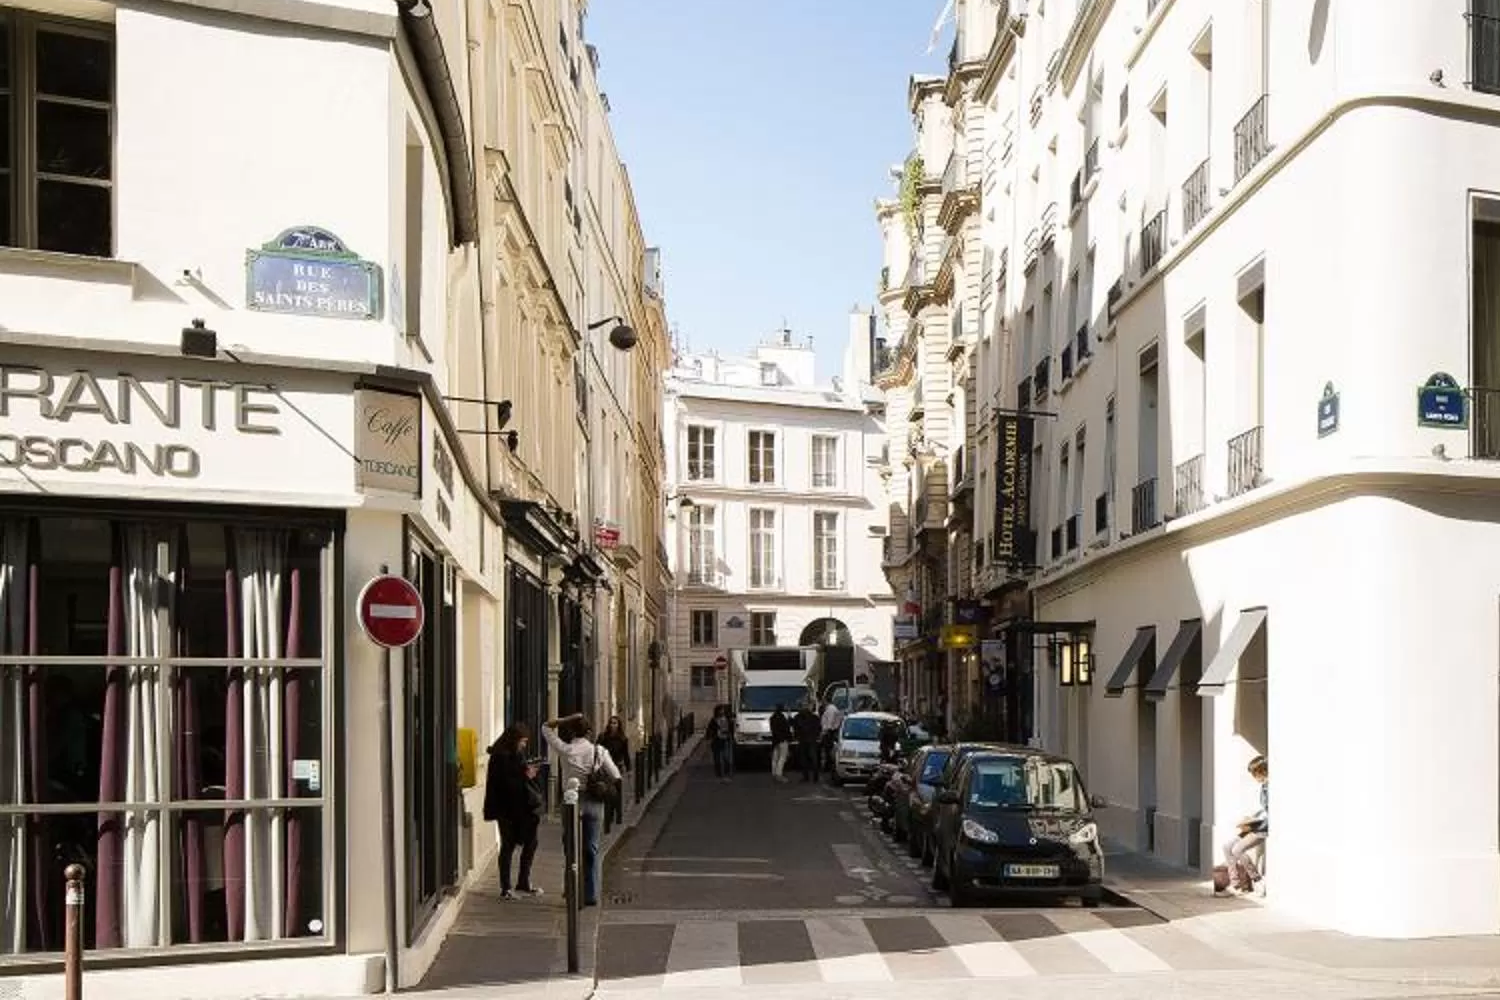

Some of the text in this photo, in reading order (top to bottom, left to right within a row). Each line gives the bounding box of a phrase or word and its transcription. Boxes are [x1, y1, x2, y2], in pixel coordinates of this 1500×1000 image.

[293, 263, 332, 279] RUE
[296, 279, 329, 293] DES
[255, 291, 313, 308] SAINTS
[999, 504, 1015, 557] HOTEL
